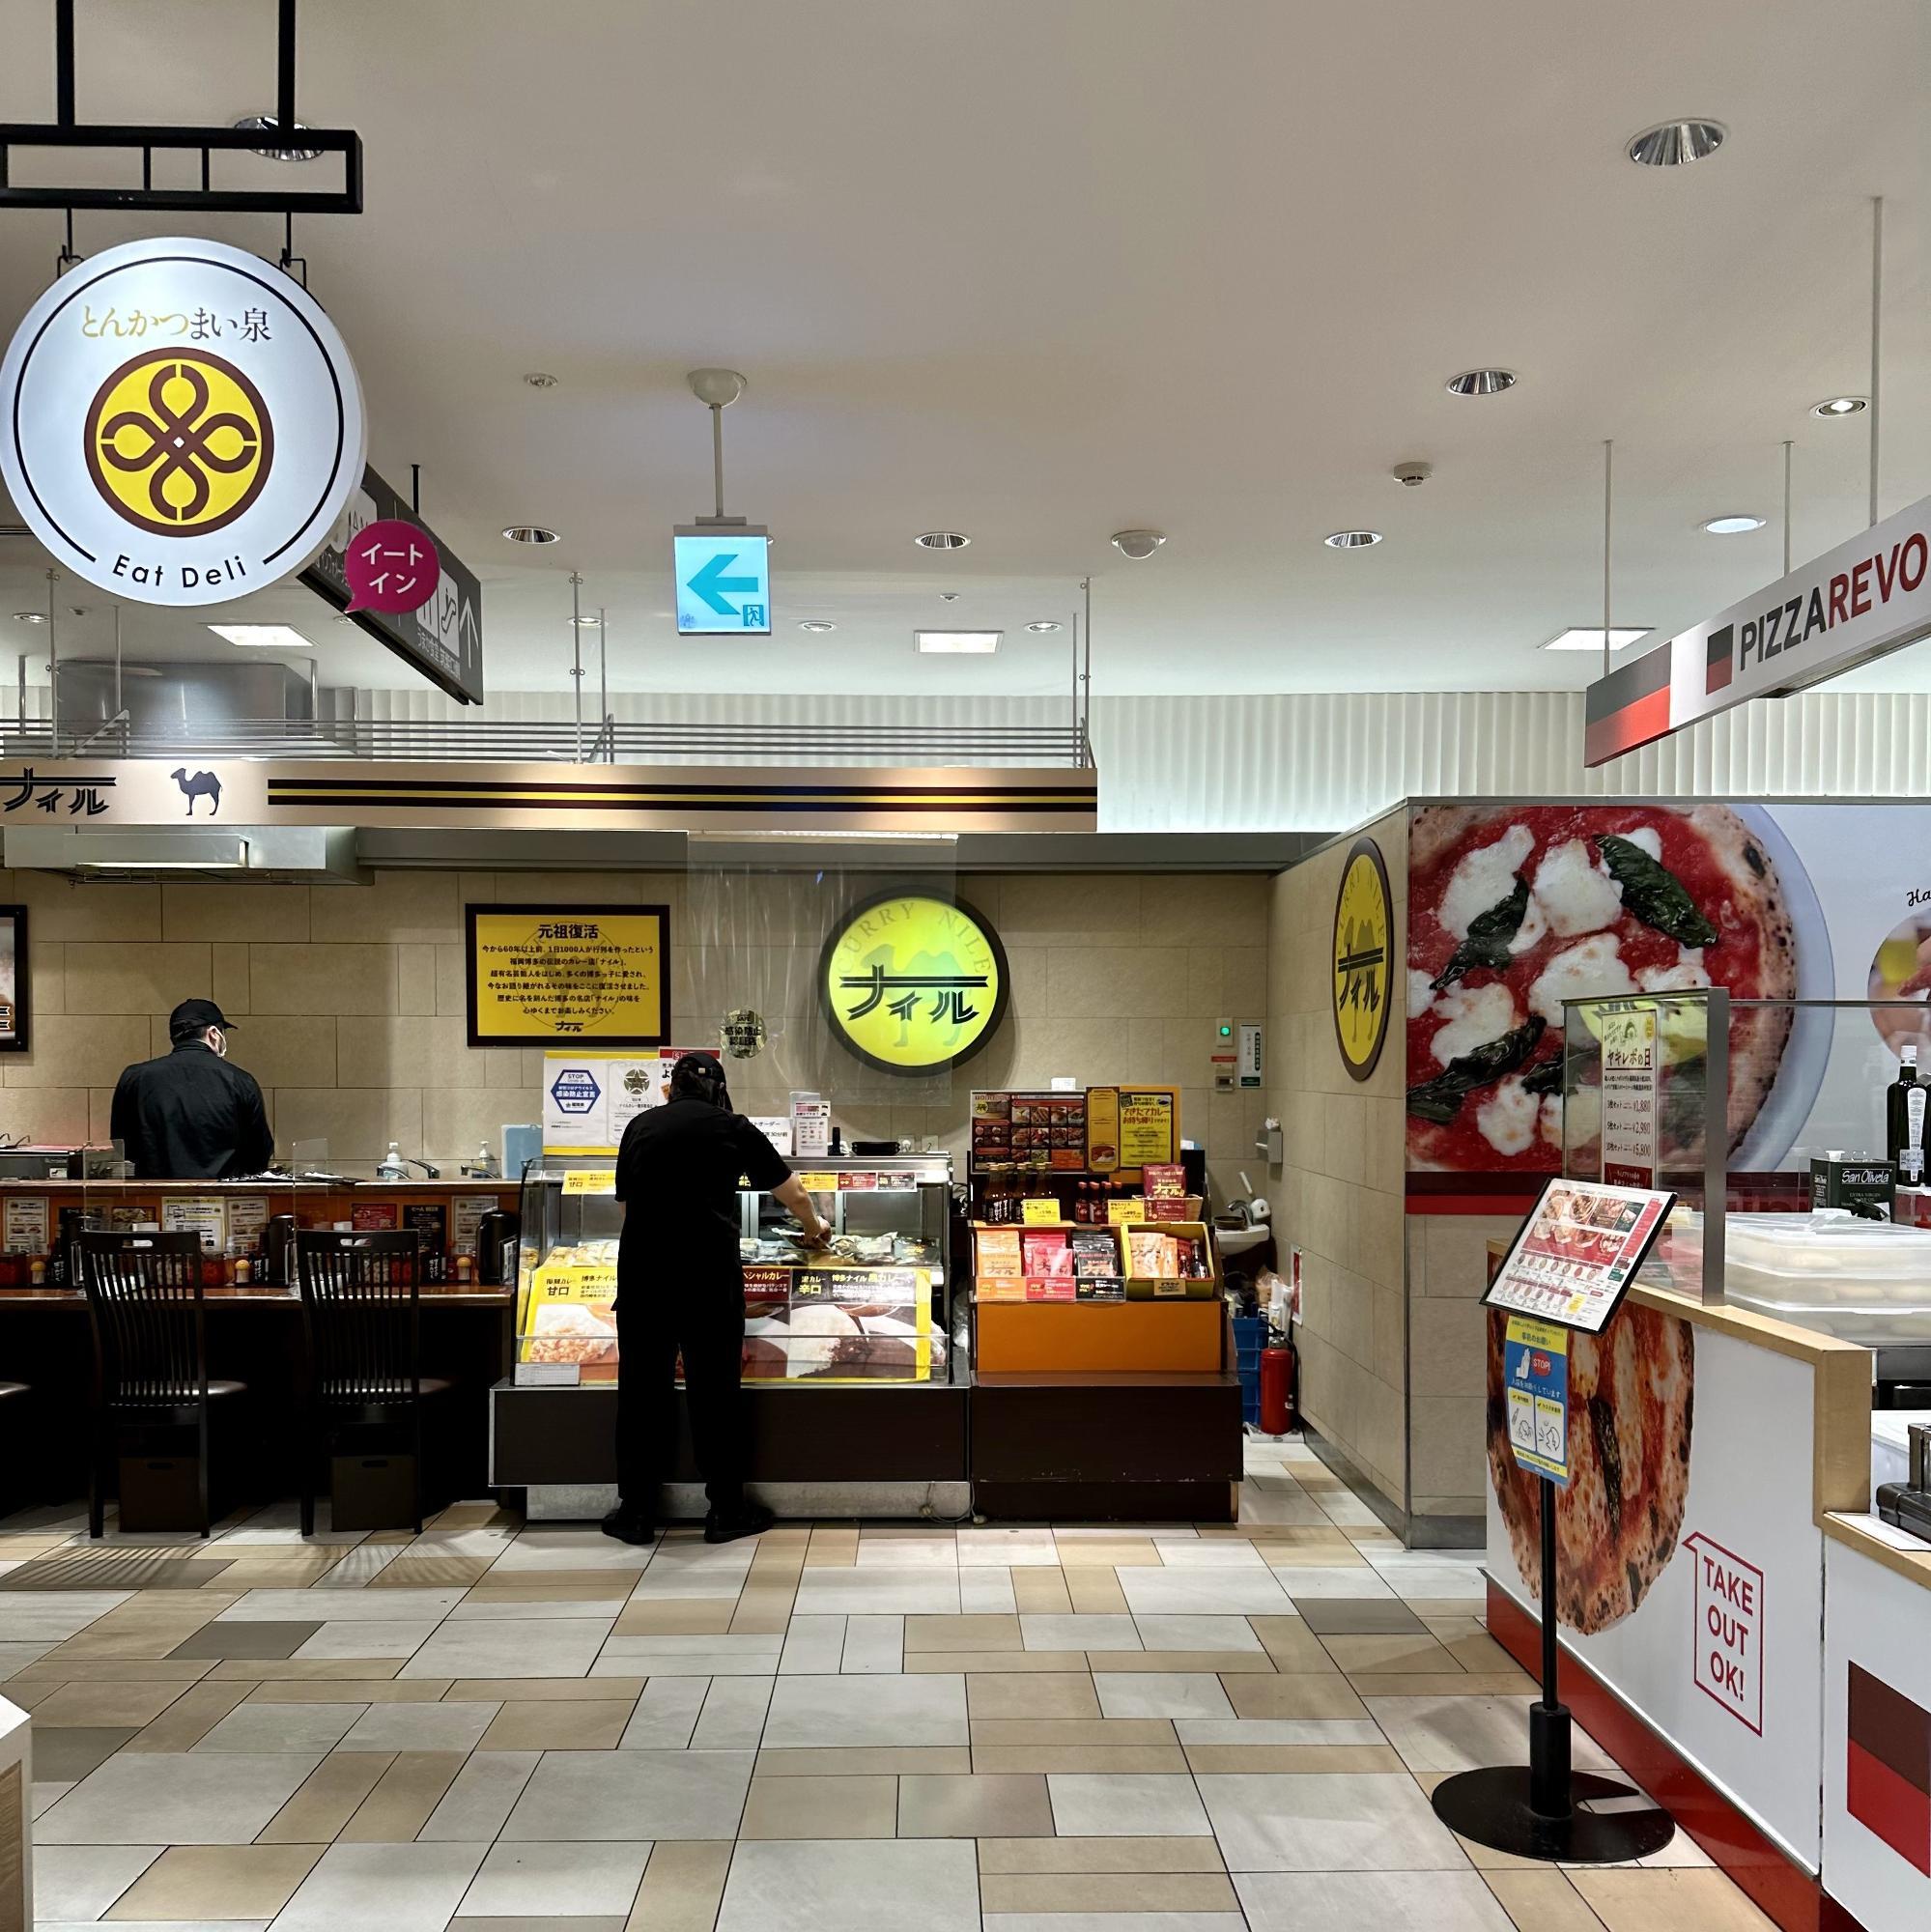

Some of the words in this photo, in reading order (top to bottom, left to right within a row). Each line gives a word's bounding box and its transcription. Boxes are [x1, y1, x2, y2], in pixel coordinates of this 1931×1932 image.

[81, 305, 272, 343] とんかつまい泉
[112, 554, 163, 587] Eat
[182, 555, 247, 588] Deli
[361, 543, 424, 566] イート
[368, 572, 417, 594] イン
[538, 923, 599, 939] 元祖復活
[837, 902, 916, 974] CURRY
[938, 910, 991, 973] NILE
[548, 1286, 569, 1295] 甘口
[799, 1284, 822, 1294] 辛口
[1704, 1555, 1753, 1616] TAKE
[1708, 1605, 1748, 1656] OUT
[1710, 1651, 1744, 1701] OK!
